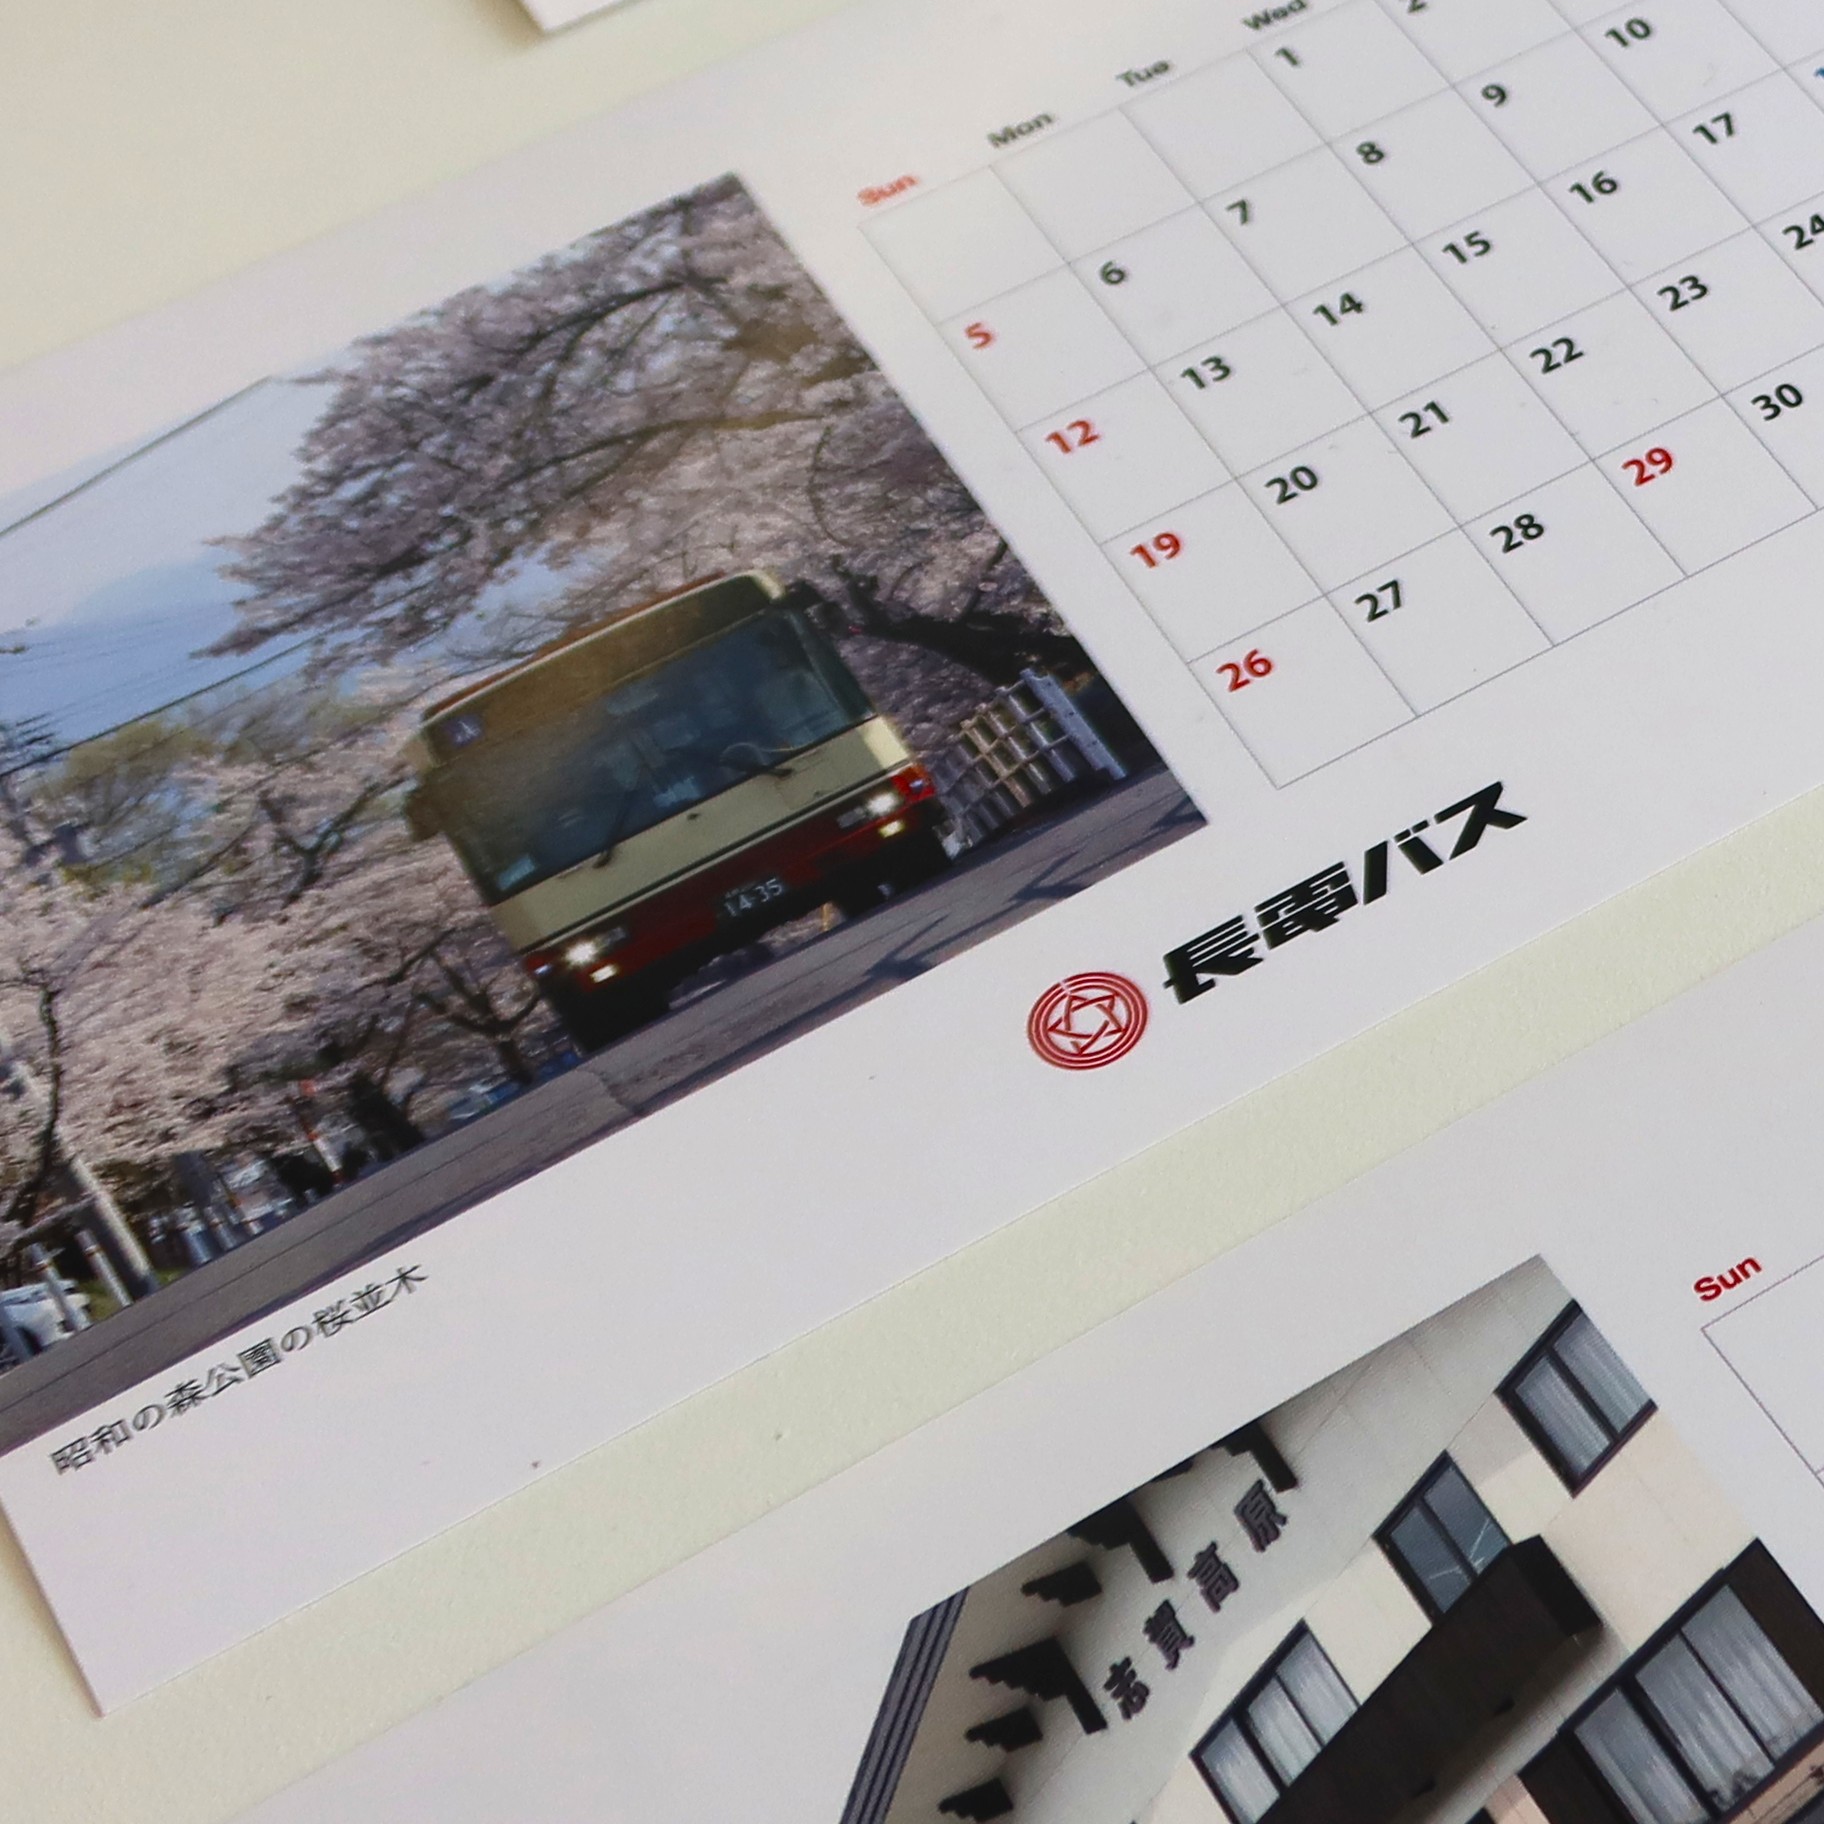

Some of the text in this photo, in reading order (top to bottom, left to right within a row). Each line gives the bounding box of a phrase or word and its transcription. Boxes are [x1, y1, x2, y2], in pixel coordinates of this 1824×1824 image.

[1046, 170, 1619, 454] 12 13 14 15 16
[1130, 532, 1182, 569] 19
[1264, 465, 1319, 505] 20
[1398, 400, 1450, 439] 21
[1529, 337, 1585, 375] 22
[1657, 275, 1709, 312] 23
[1217, 383, 1804, 692] 26 27 28 29 30
[1163, 781, 1527, 1004] 長電バス
[50, 1265, 427, 1475] 昭和の森公園の桜並木
[1692, 1256, 1763, 1303] Sun
[1103, 1478, 1288, 1721] 志賀高原
